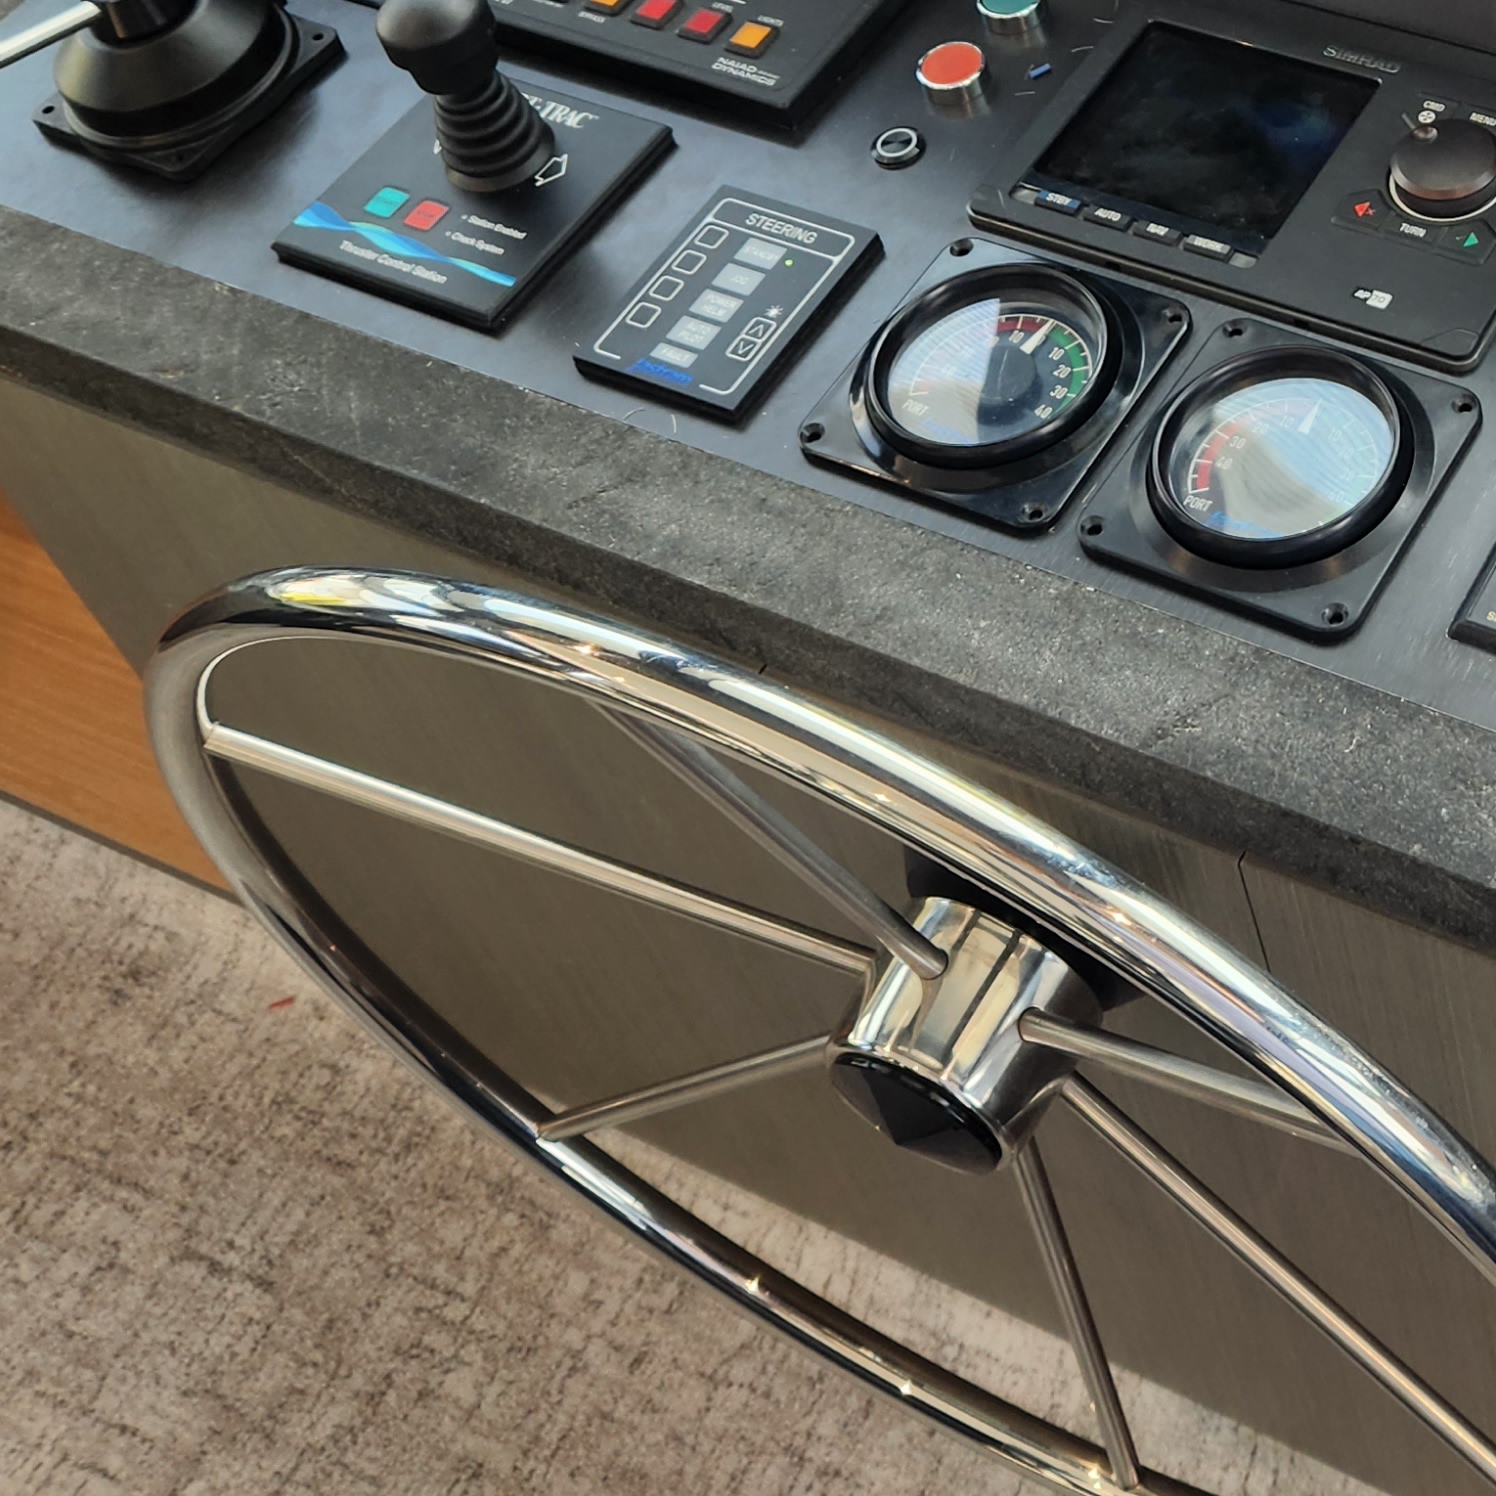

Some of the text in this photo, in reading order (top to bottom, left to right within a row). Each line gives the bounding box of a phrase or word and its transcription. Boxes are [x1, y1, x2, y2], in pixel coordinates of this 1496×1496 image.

[717, 57, 758, 73] NAIAD
[711, 63, 777, 86] DYNAMICS
[1095, 208, 1121, 221] AUTO
[745, 213, 818, 244] STEERING
[1400, 223, 1427, 237] TURN
[1009, 330, 1024, 343] 10
[1049, 347, 1064, 360] 10
[1053, 365, 1071, 378] 20
[1050, 385, 1067, 399] 30
[902, 400, 930, 416] PORT
[1034, 405, 1052, 418] 40
[1252, 422, 1269, 435] 20
[1230, 436, 1247, 449] 30
[1216, 457, 1233, 470] 40
[1184, 495, 1213, 512] PORT
